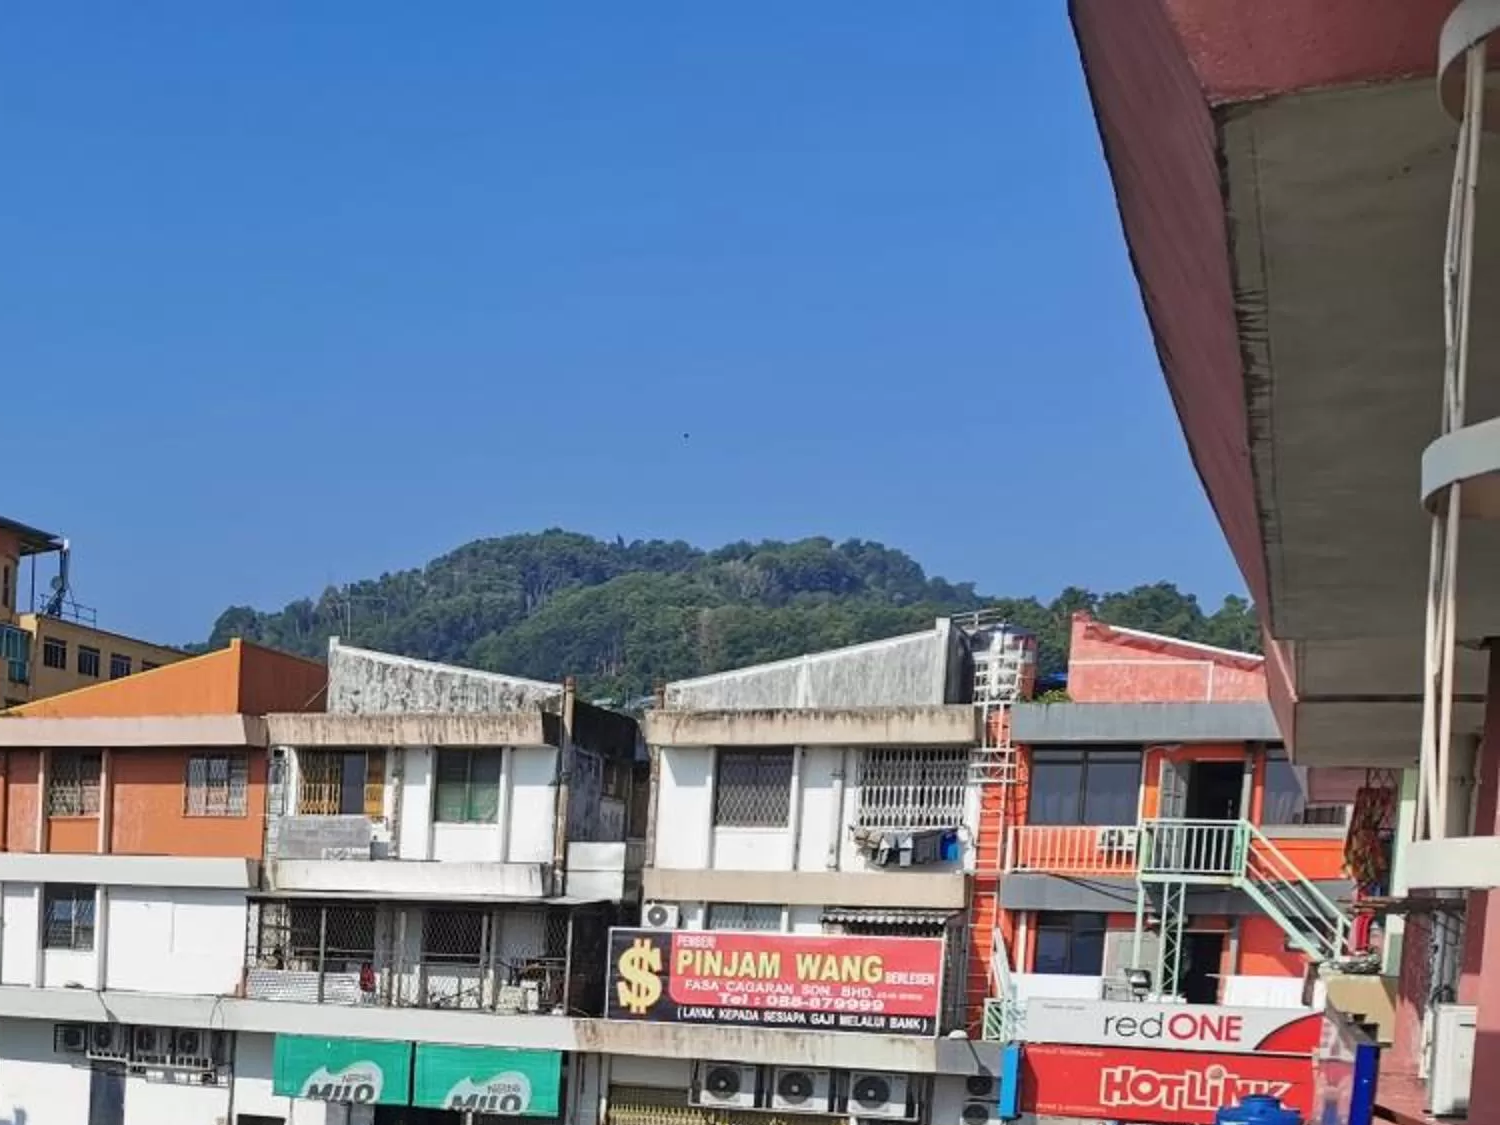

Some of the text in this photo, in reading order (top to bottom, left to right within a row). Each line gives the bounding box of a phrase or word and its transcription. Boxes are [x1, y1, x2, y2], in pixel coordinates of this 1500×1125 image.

[675, 949, 781, 979] PINJAM
[795, 952, 884, 984] WANG
[725, 981, 794, 995] CAGARAN
[718, 1007, 759, 1021] KEPADA
[763, 1010, 807, 1024] SESIAPA
[810, 1012, 835, 1025] GAJI
[839, 1014, 885, 1028] MELALUI
[307, 1083, 375, 1104] MILO
[451, 1093, 522, 1112] MILO
